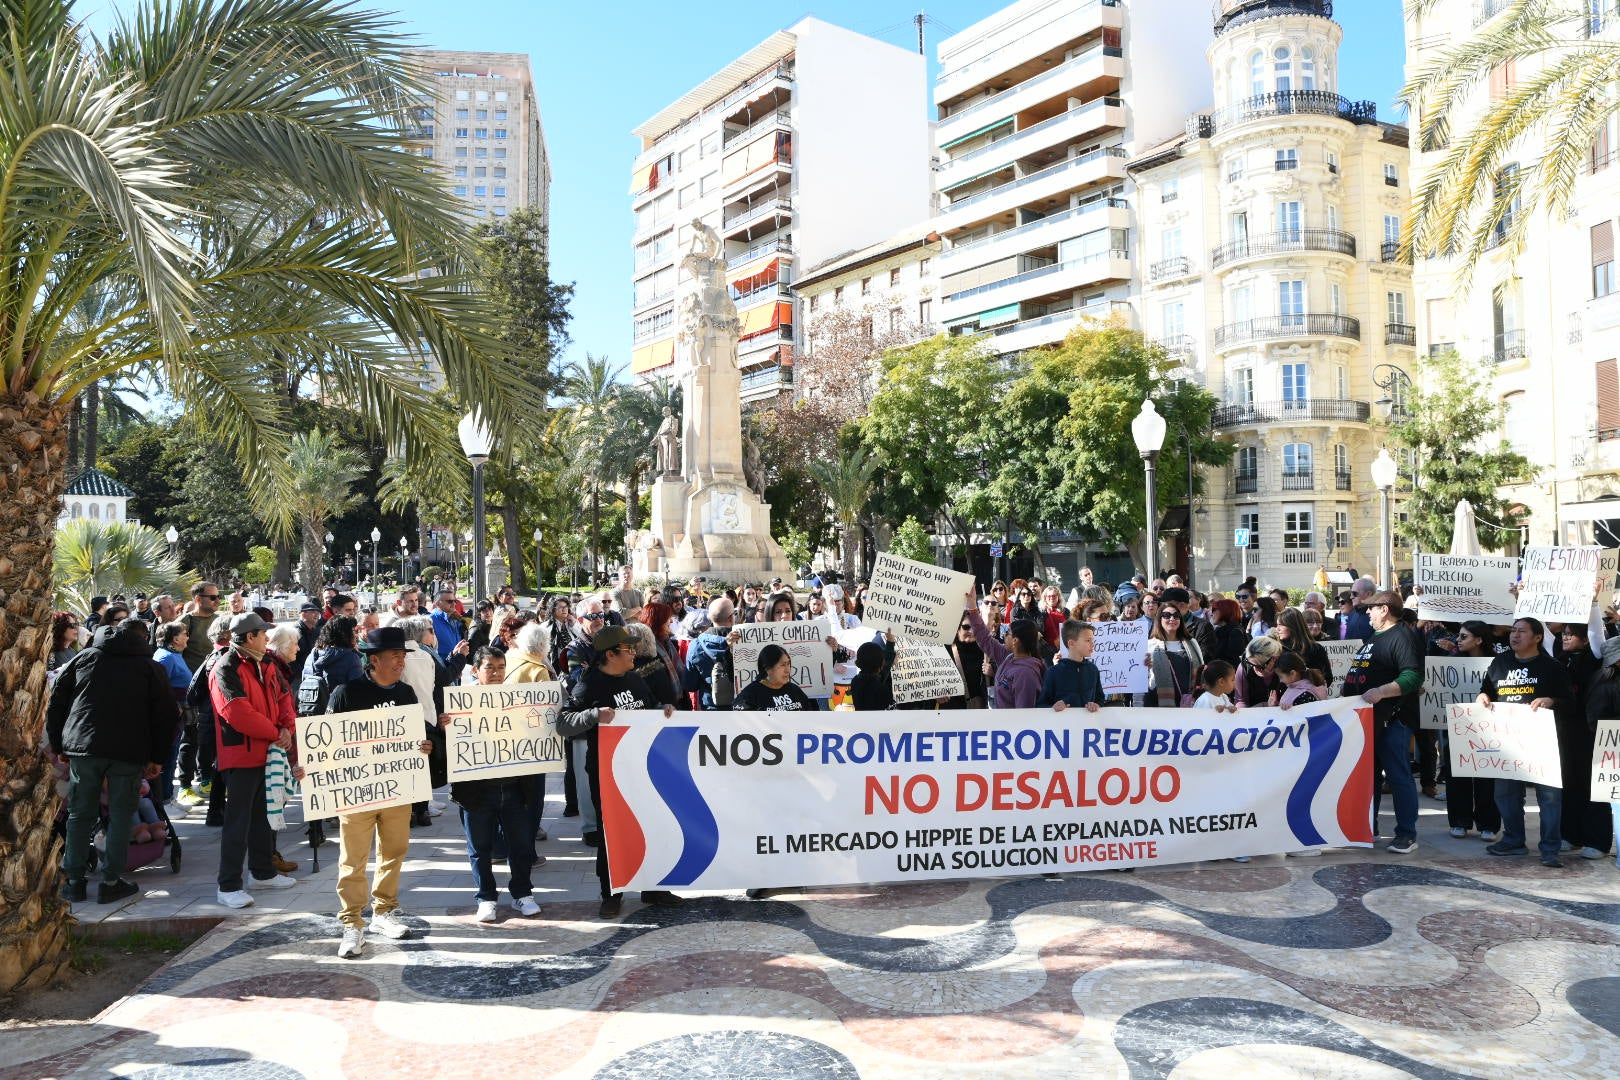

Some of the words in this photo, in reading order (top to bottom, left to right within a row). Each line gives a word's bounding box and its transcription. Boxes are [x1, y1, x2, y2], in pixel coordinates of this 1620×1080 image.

[879, 556, 906, 572] PARA
[909, 565, 932, 579] TODO
[934, 573, 952, 584] HAY
[1439, 556, 1479, 569] TRABAJO
[1484, 560, 1496, 568] ES
[1497, 561, 1511, 569] UN
[1421, 569, 1474, 583] DERECHO
[874, 579, 883, 588] SI
[886, 583, 902, 593] HAY
[906, 588, 946, 606] VOLUNTAD
[870, 592, 897, 606] PERO
[899, 599, 913, 610] NO
[914, 604, 934, 616] NOS
[866, 606, 902, 624] QUITEN
[904, 615, 938, 627] NUESTRO
[903, 624, 940, 639] TRABAJO
[1507, 668, 1528, 681] NOS
[449, 691, 473, 711] NO
[500, 689, 560, 709] DESALOJO
[613, 689, 634, 707] NOS
[773, 693, 793, 706] NOS
[305, 721, 333, 749] 60
[453, 717, 472, 735] SI
[479, 717, 490, 734] A
[495, 716, 512, 733] LA
[453, 729, 563, 767] REUBICACIÓN
[699, 733, 783, 766] NOS
[797, 729, 1070, 765] PROMETIERON
[1083, 719, 1306, 758] REUBICACIÓN
[1468, 738, 1501, 750] NO
[307, 754, 314, 764] A
[317, 751, 328, 763] LA
[333, 746, 361, 761] CALLE
[372, 744, 385, 755] NO
[307, 763, 370, 788] TENEMOS
[374, 757, 425, 776] DERECHO
[865, 774, 940, 815] NO
[956, 765, 1181, 812] DESALOJO
[310, 794, 320, 810] A
[756, 835, 779, 854] EL
[786, 831, 898, 853] MERCADO
[905, 828, 973, 848] HIPPIE
[979, 826, 1005, 844] DE
[1012, 825, 1036, 843] LA
[1043, 818, 1164, 841] EXPLANADA
[1169, 812, 1257, 834] NECESITA
[897, 852, 945, 872] UNA
[952, 847, 1057, 869] SOLUCION
[1065, 841, 1157, 863] URGENTE
